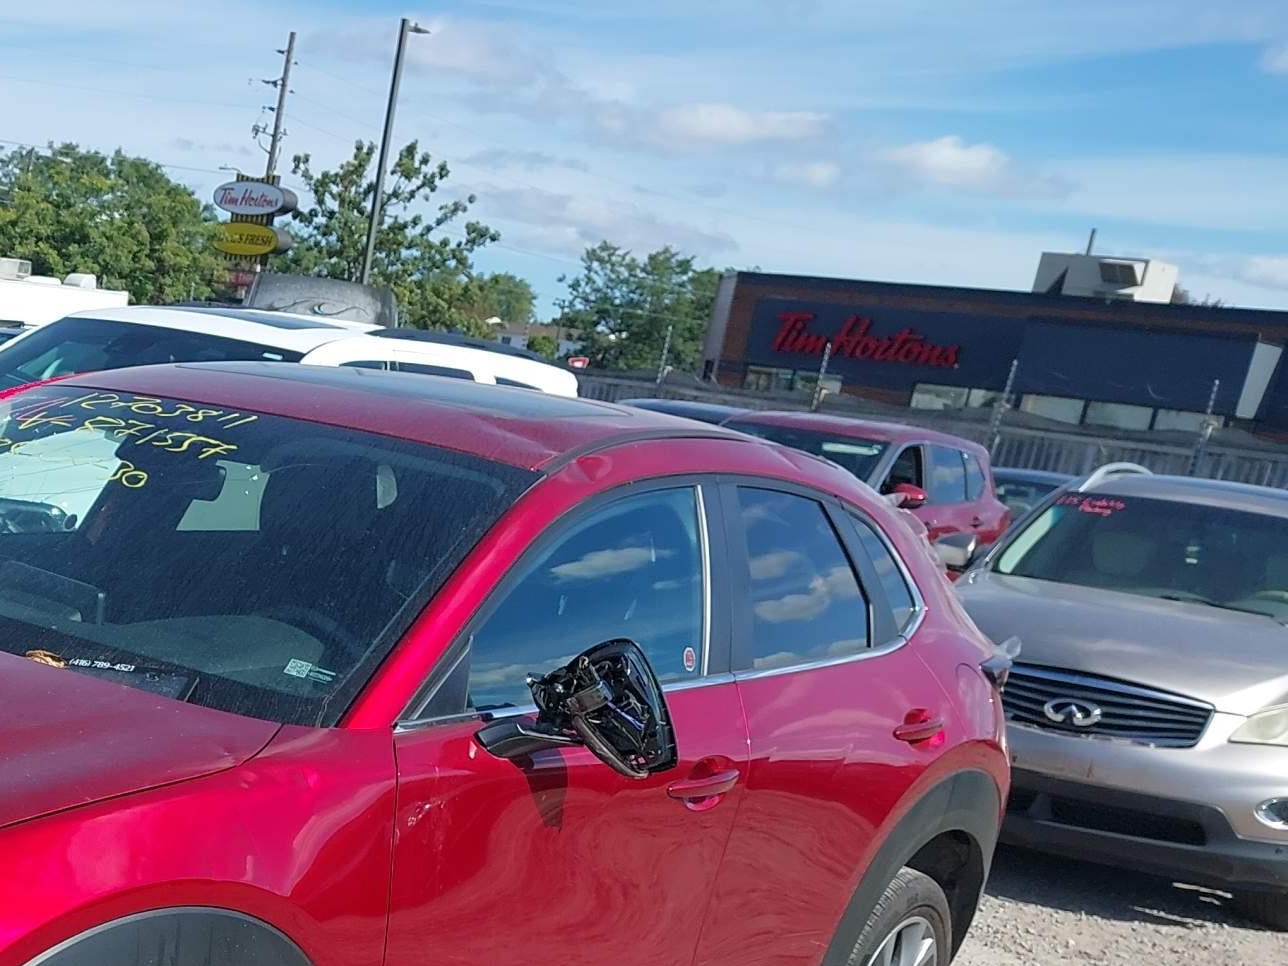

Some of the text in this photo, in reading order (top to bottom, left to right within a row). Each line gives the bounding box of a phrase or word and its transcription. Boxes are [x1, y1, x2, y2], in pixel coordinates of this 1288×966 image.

[219, 187, 279, 207] Tim Hortons
[772, 312, 960, 367] Tim Hortons
